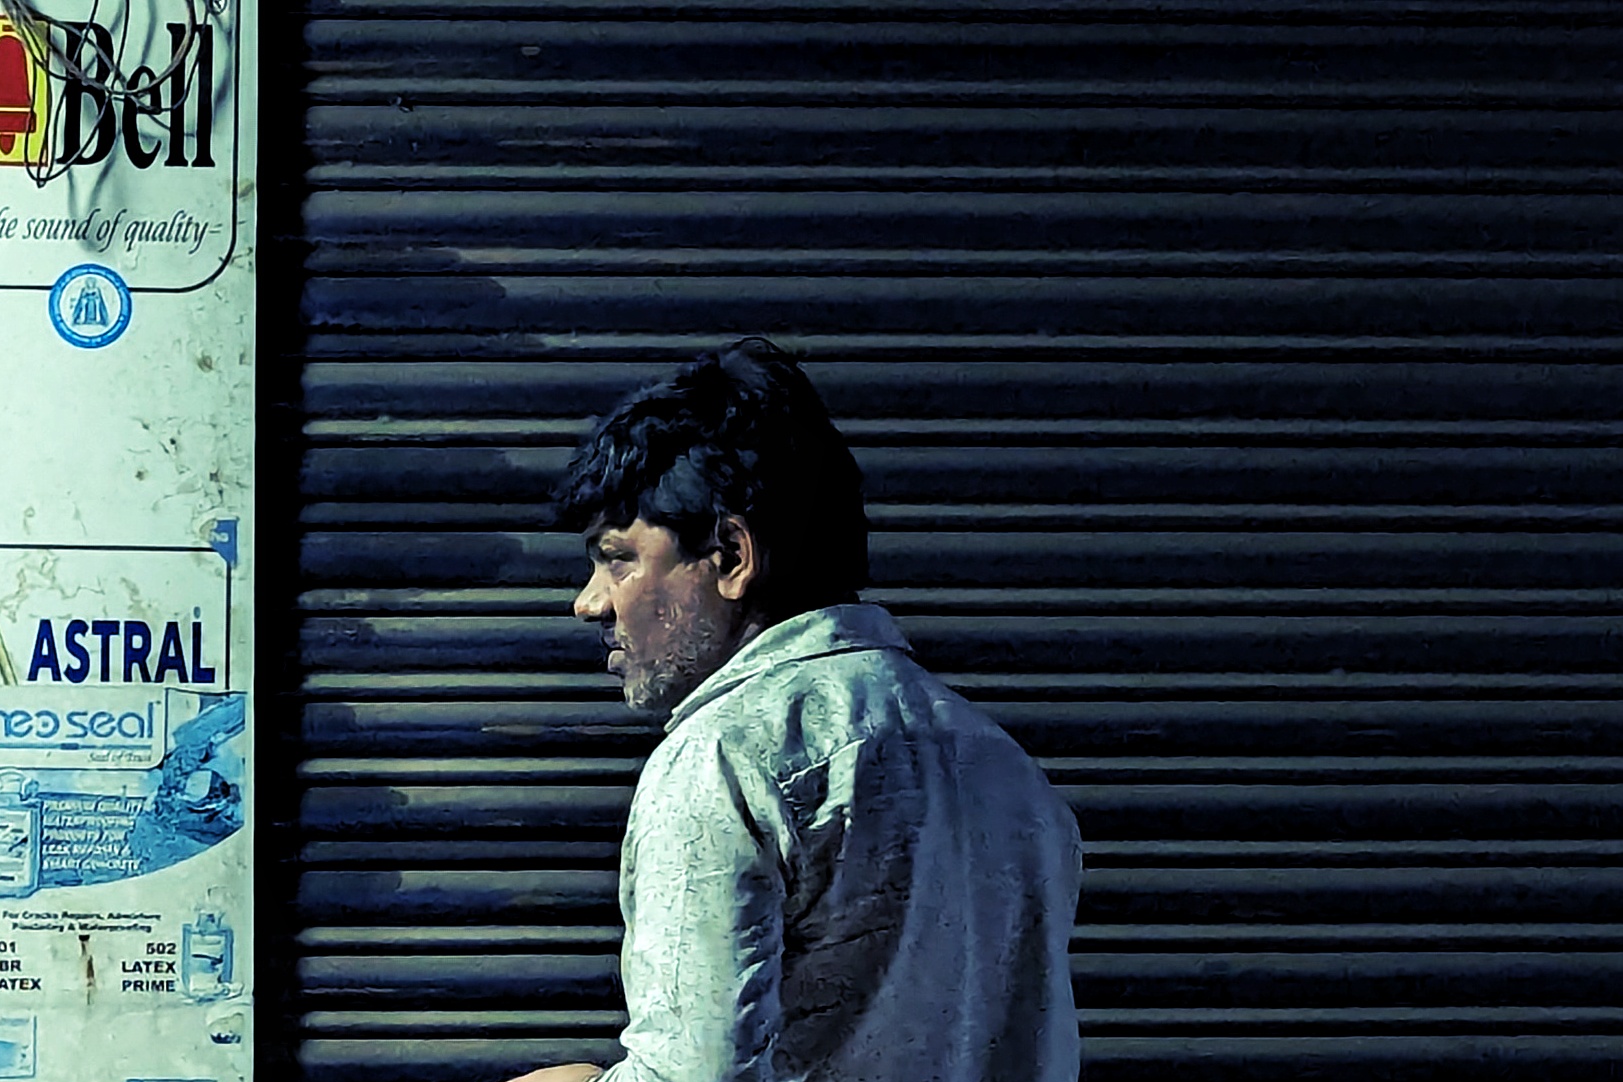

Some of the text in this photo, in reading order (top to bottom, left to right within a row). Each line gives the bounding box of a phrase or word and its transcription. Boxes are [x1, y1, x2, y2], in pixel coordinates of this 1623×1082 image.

[56, 21, 216, 169] Bell
[22, 208, 100, 241] sound
[97, 208, 127, 252] of
[125, 210, 211, 254] quality
[27, 619, 215, 684] ASTRAL
[146, 943, 176, 955] 502
[122, 961, 176, 974] LATEX
[122, 980, 176, 992] PRIME
